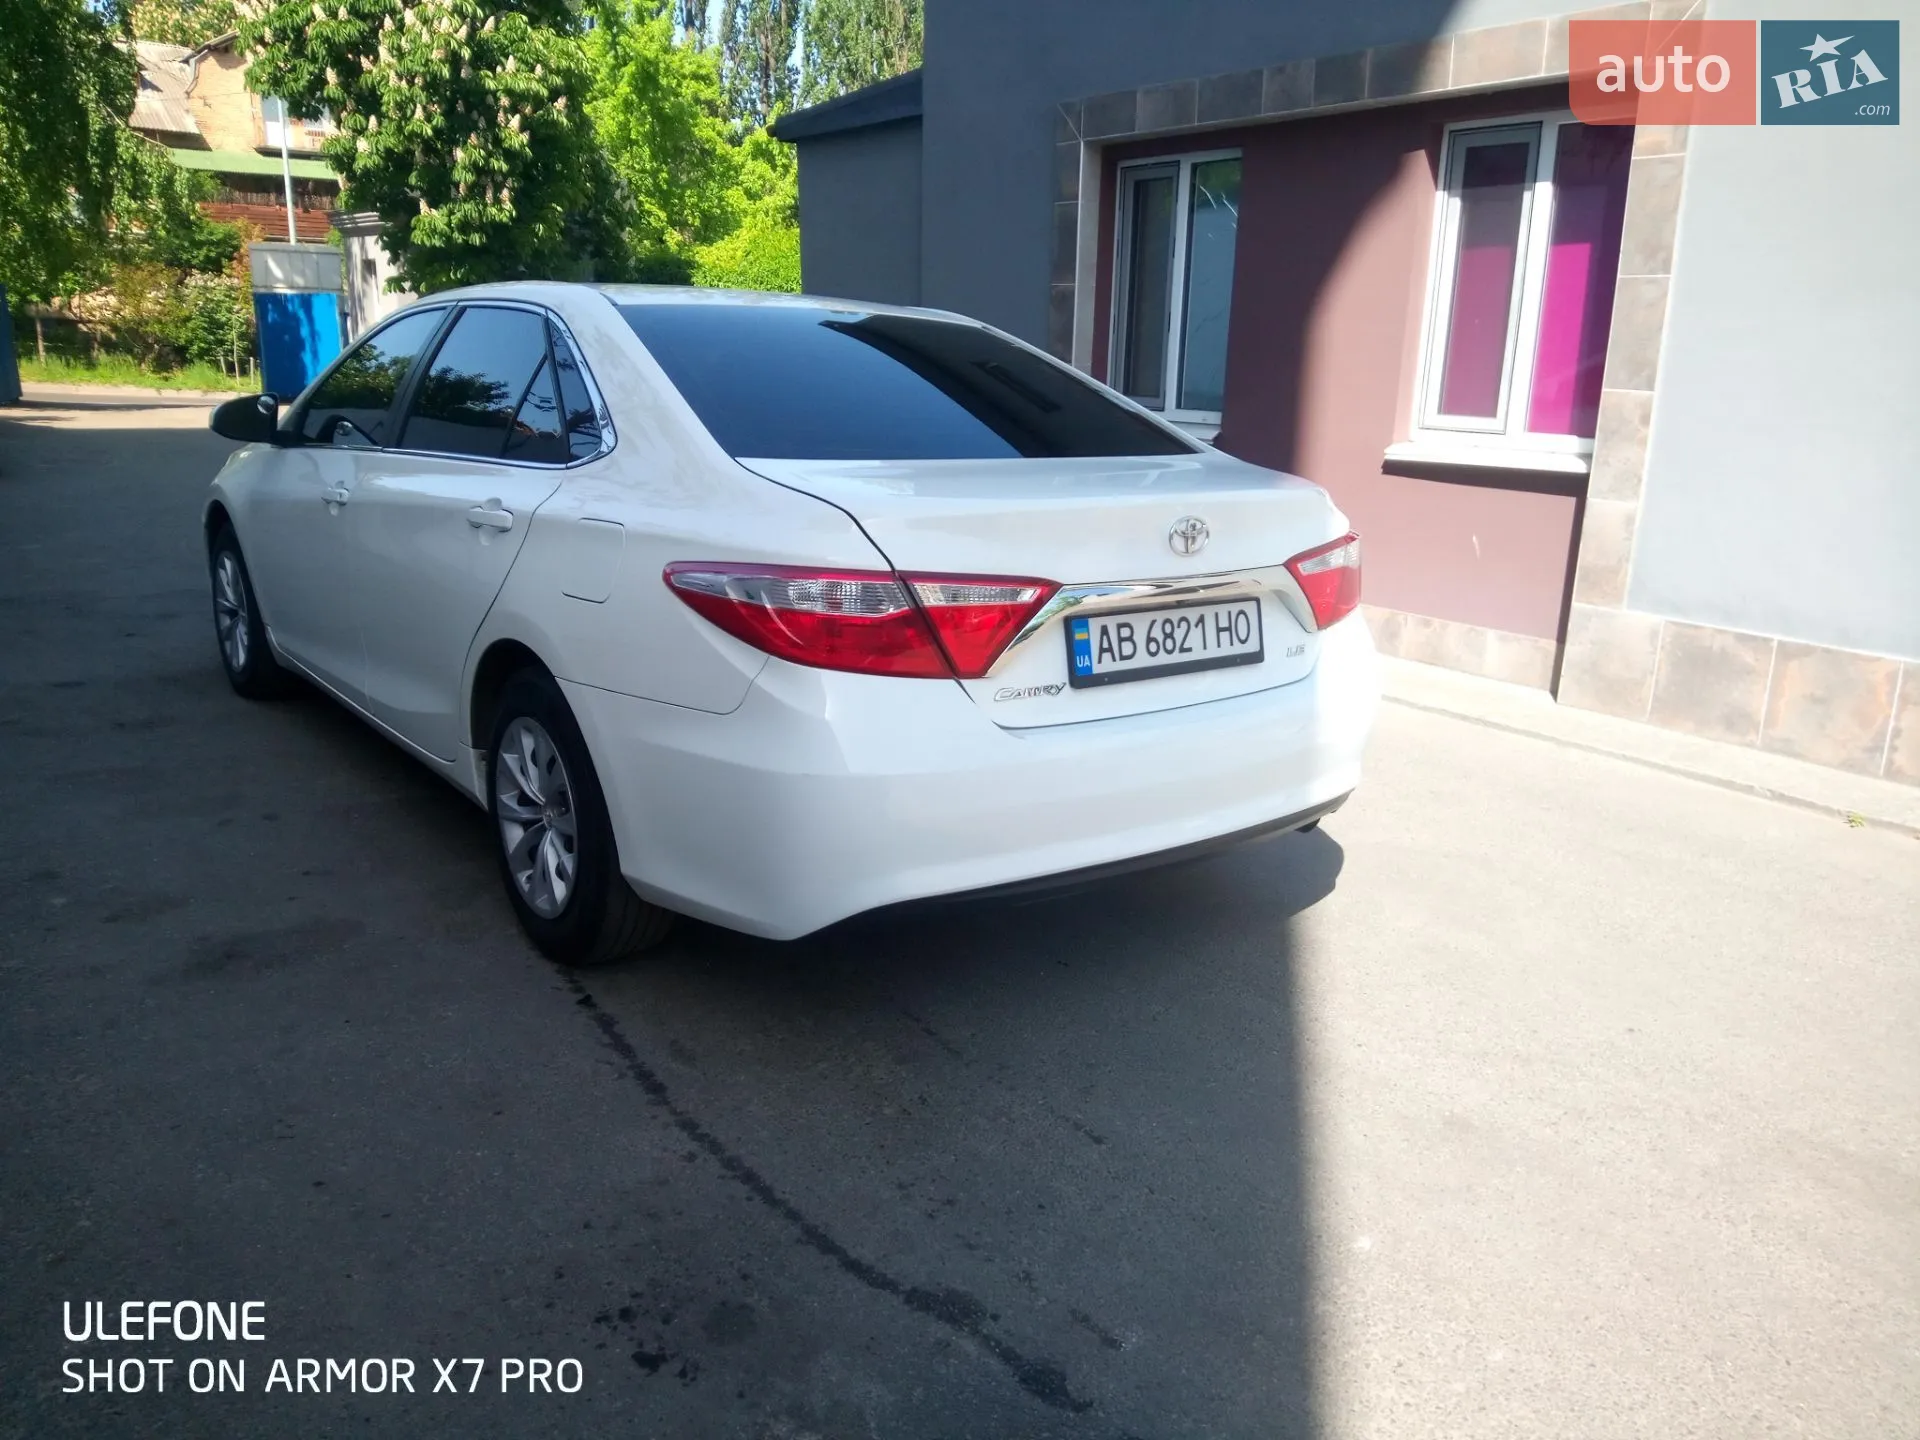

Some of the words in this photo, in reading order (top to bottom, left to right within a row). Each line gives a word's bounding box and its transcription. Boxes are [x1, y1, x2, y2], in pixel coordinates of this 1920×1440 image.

[1097, 622, 1137, 664] AB
[1145, 613, 1207, 657] 6821
[1215, 609, 1251, 648] HO
[1076, 655, 1091, 668] UA
